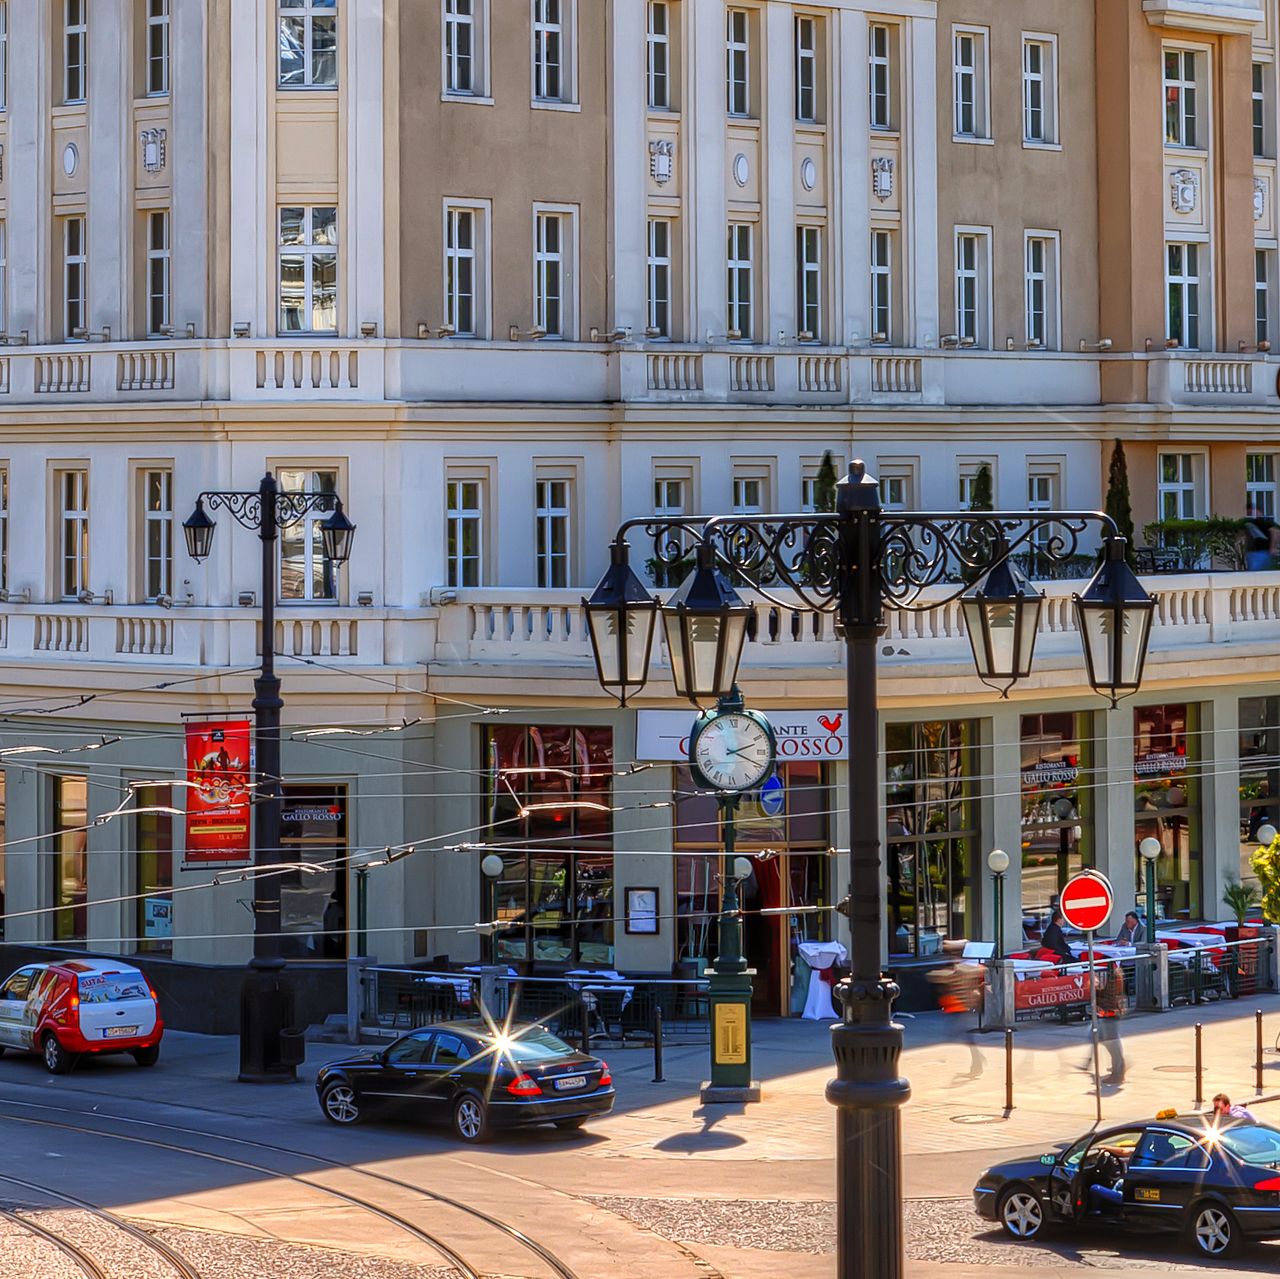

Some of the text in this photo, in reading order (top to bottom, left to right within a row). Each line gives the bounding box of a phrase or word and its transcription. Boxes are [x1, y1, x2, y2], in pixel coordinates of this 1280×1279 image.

[1135, 758, 1187, 773] GALLO ROSSO
[1024, 769, 1078, 784] GALLO ROSSO
[282, 813, 341, 821] GALLO ROSSO
[1028, 988, 1084, 1006] GALLO ROSSO
